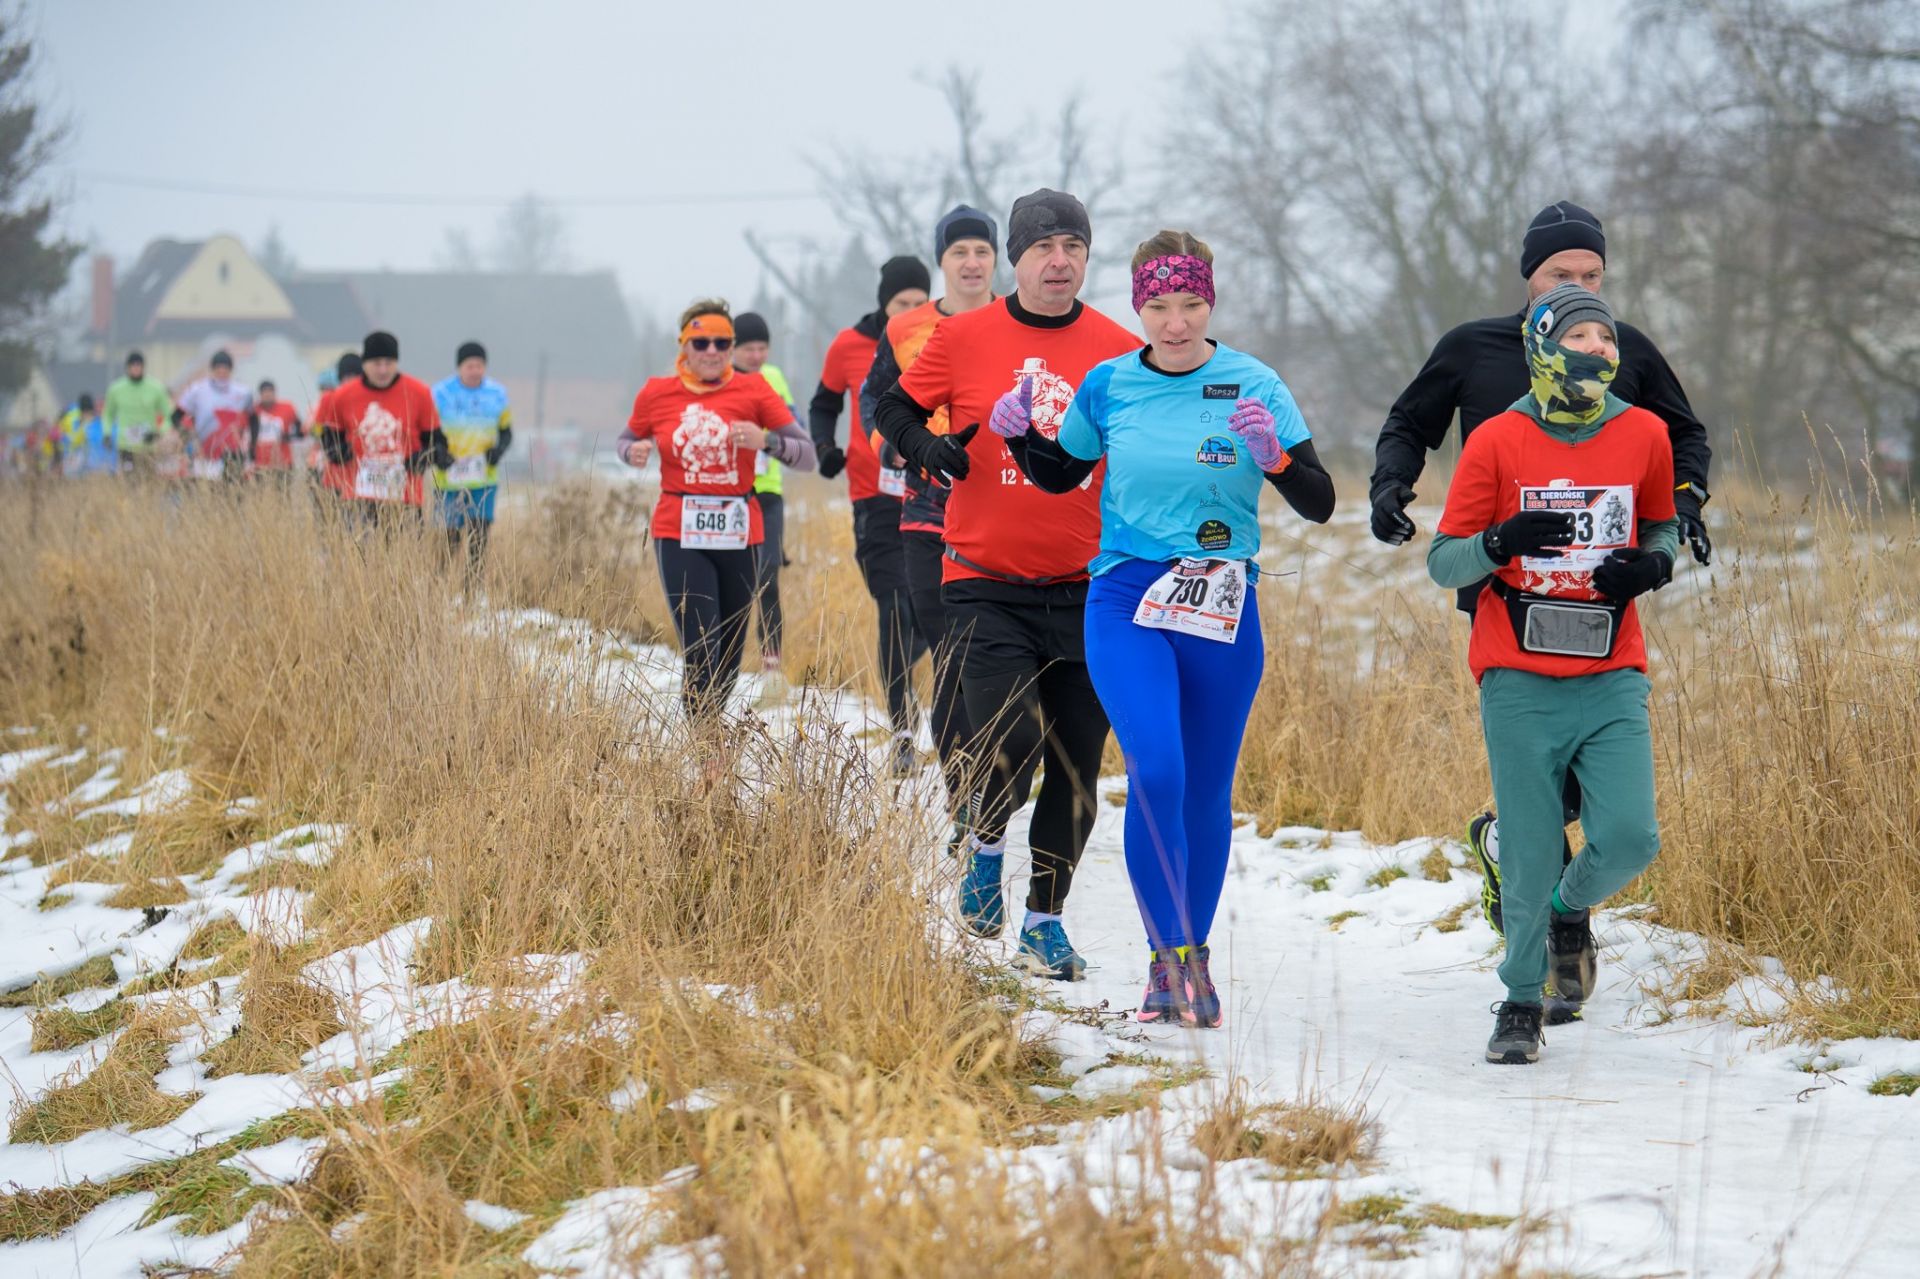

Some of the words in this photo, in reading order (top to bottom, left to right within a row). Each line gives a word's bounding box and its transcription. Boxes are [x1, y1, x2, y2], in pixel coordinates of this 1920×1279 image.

[1198, 452, 1216, 462] MAT
[1218, 453, 1236, 463] BRUK
[1001, 469, 1017, 485] 12
[1540, 490, 1585, 500] BIERUŃSKI
[1526, 500, 1547, 509] BIEG
[1550, 500, 1586, 509] UTOPCA
[696, 512, 726, 531] 648
[1165, 577, 1209, 607] 730
